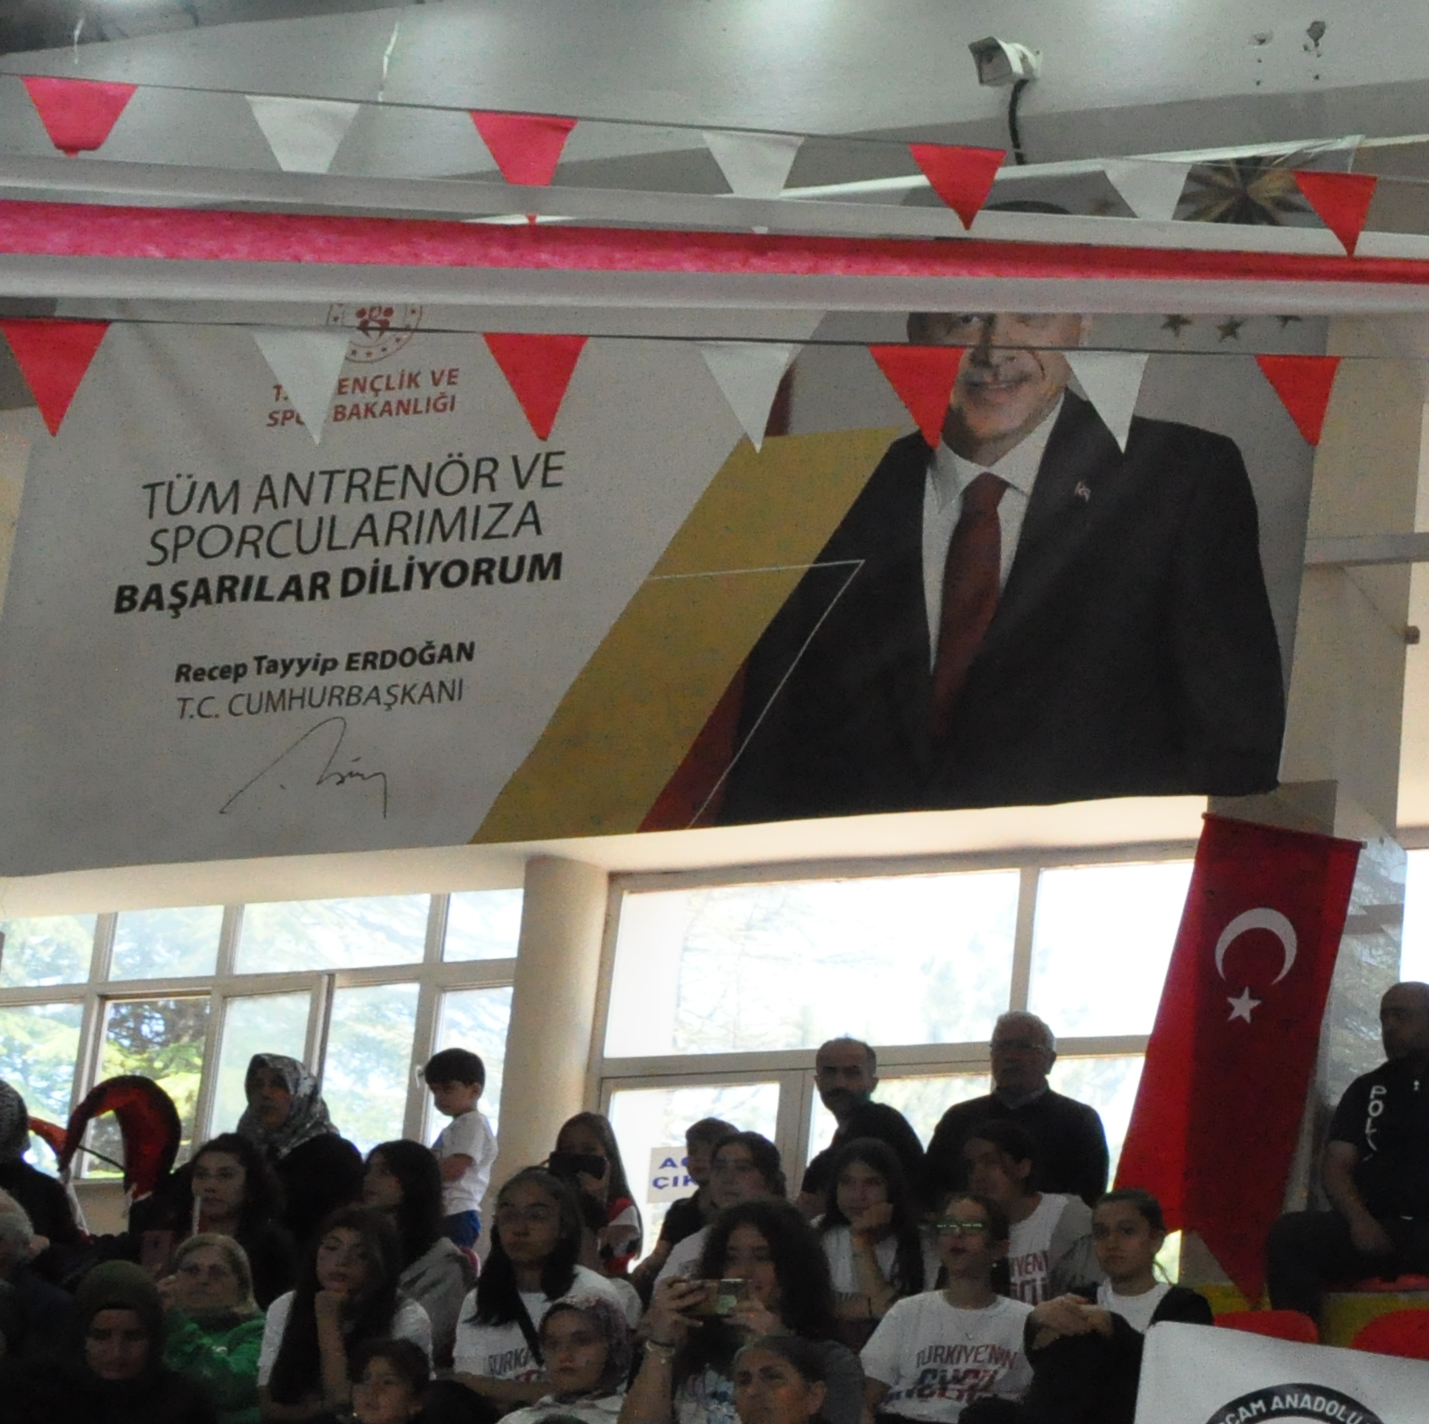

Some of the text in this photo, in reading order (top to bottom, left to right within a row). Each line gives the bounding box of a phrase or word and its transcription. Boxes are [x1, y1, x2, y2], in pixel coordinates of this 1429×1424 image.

[336, 368, 422, 398] ENÇLİK
[430, 367, 461, 388] VE
[332, 391, 457, 423] BAKANLIĞI
[142, 450, 567, 520] TÜM ANTRENÖR VE
[146, 500, 543, 567] SPORCULARIMIZA
[113, 551, 563, 619] BAŞARILAR DİLİYORUM
[174, 639, 476, 684] Recep Tayyip ERDOĞAN
[177, 677, 464, 720] T.C. CUMHURBAŞKANI
